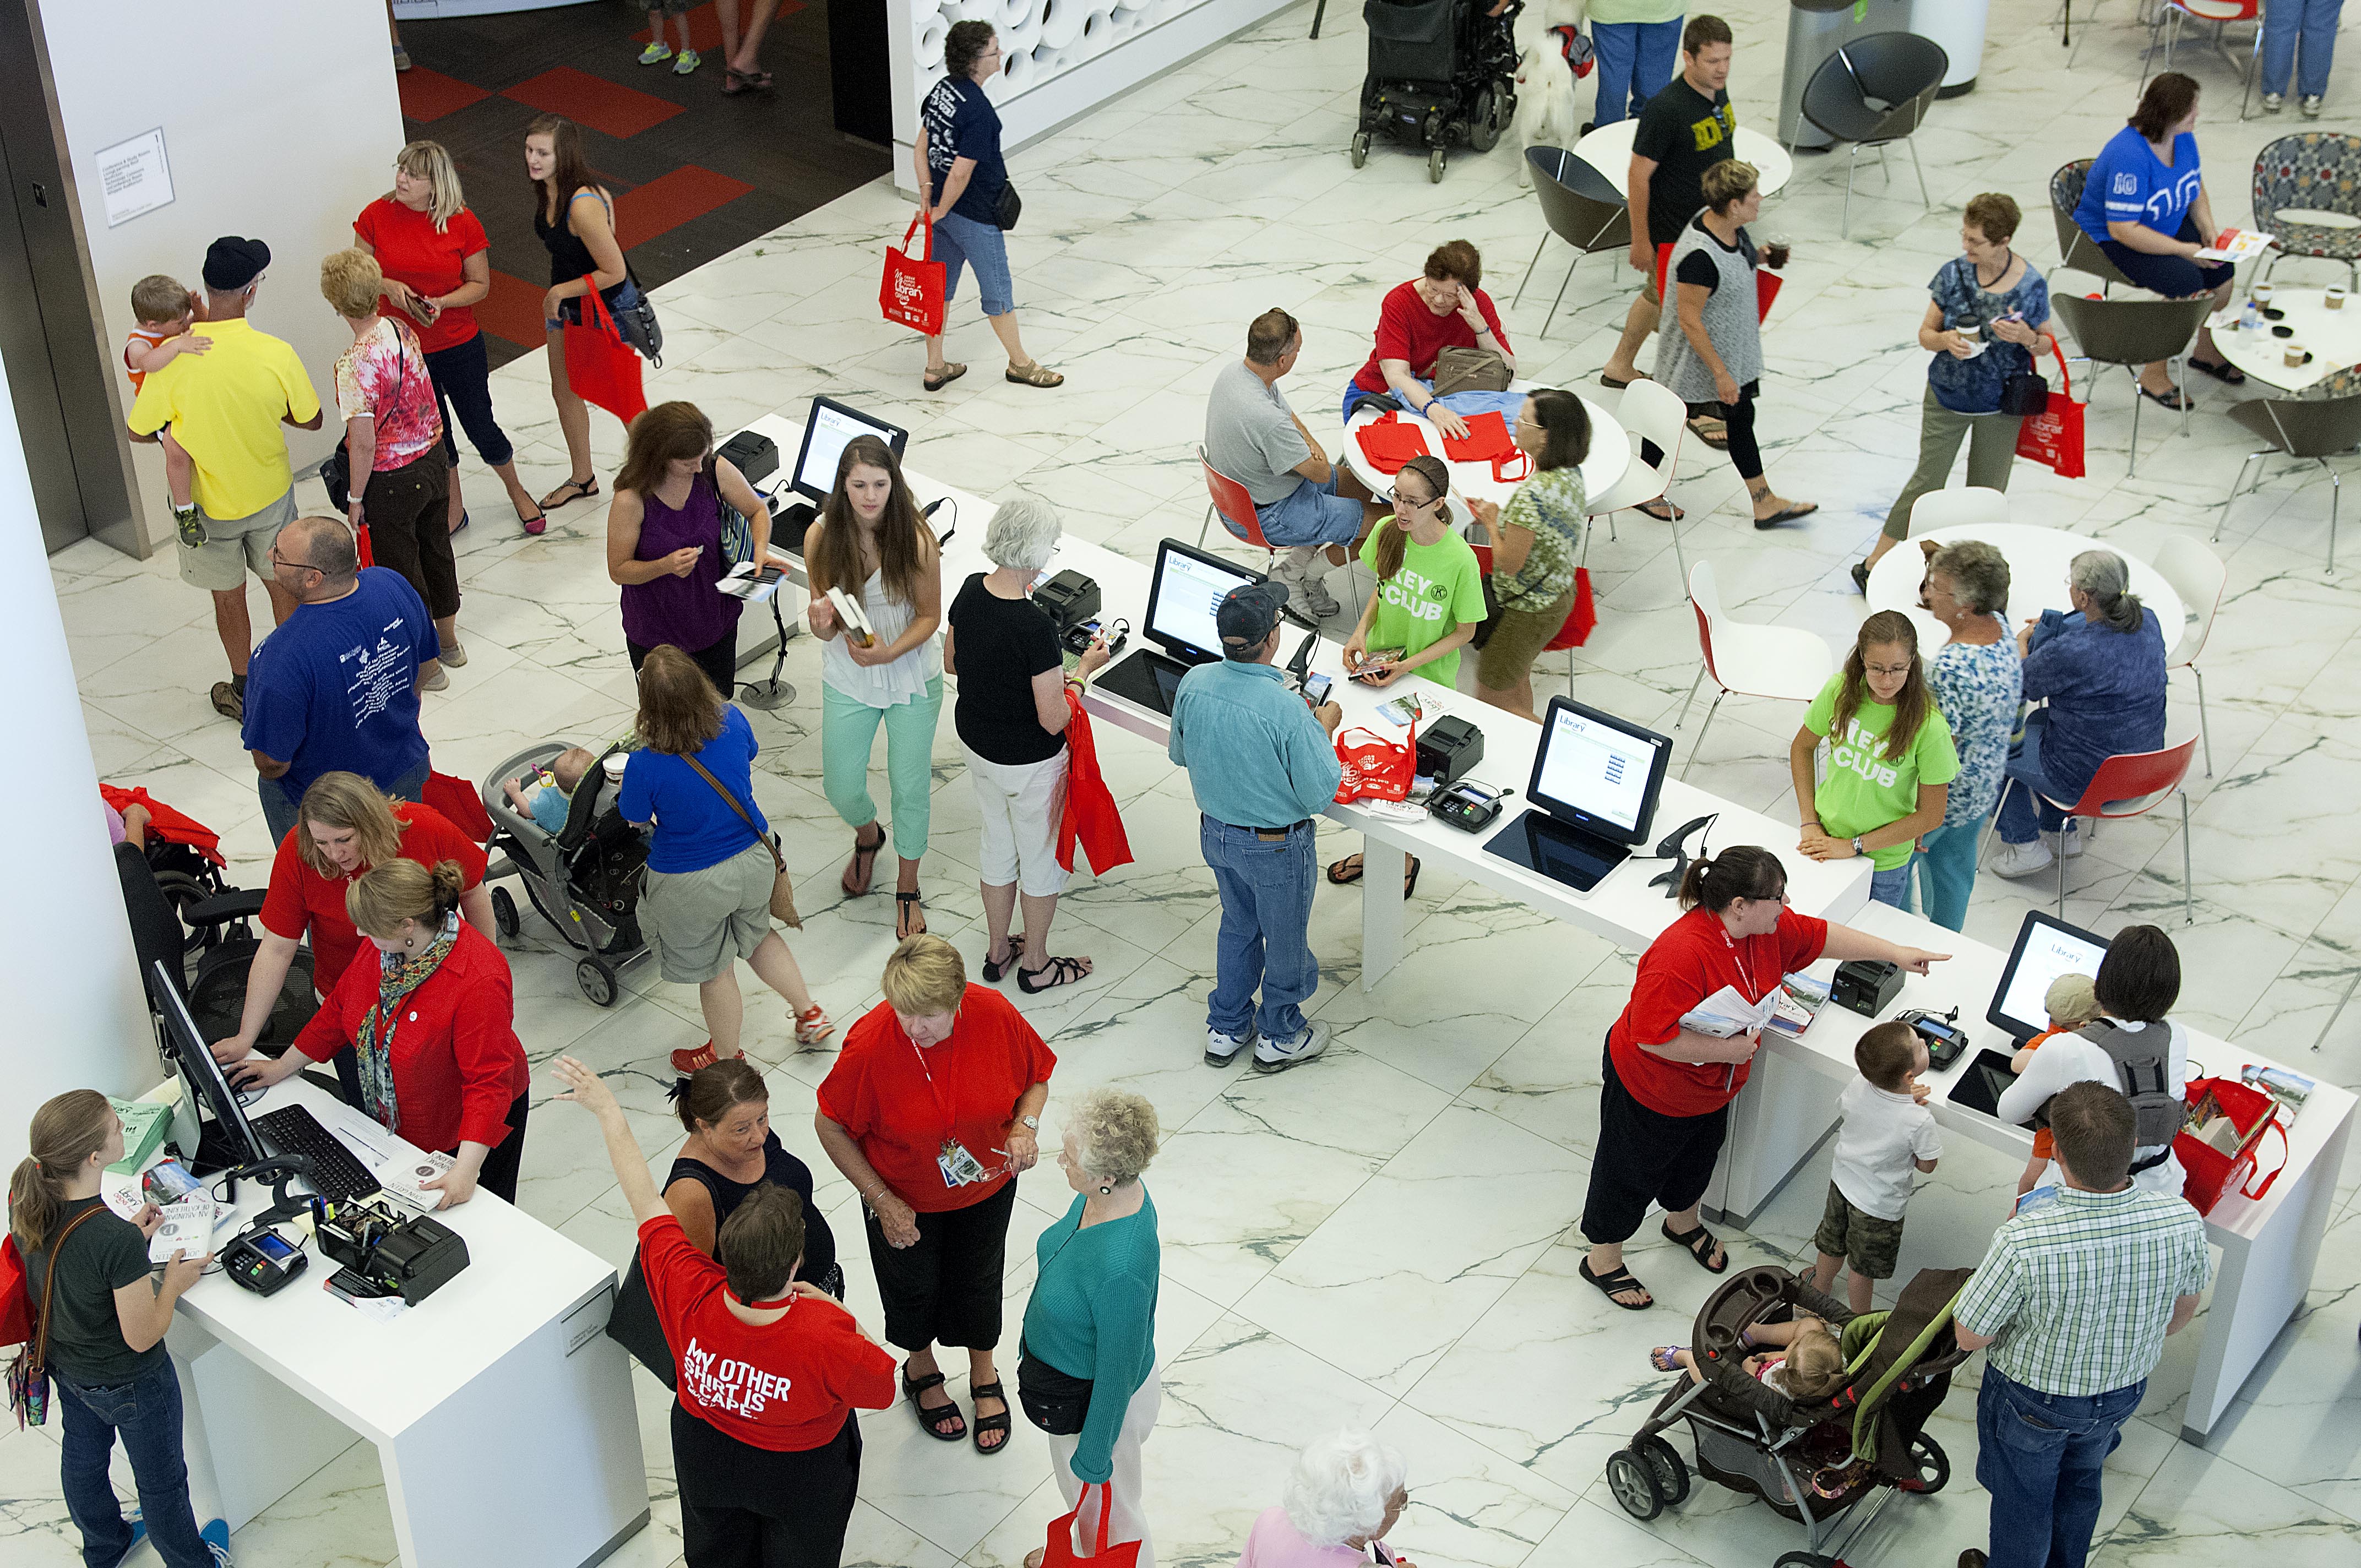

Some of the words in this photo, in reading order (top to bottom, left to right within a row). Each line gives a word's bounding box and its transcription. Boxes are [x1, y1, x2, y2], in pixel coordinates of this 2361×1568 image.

[2113, 173, 2137, 195] 10
[1169, 556, 1192, 571] Library
[1385, 585, 1443, 620] CLUB
[1560, 715, 1586, 732] Library
[1834, 747, 1897, 788] CLUB
[2052, 943, 2083, 963] Library
[119, 1188, 140, 1206] Library
[166, 1212, 196, 1221] ABUNDAN
[687, 1337, 716, 1373] MY
[719, 1359, 791, 1402] OTHER
[684, 1356, 740, 1400] SHIRT
[744, 1389, 766, 1412] IS
